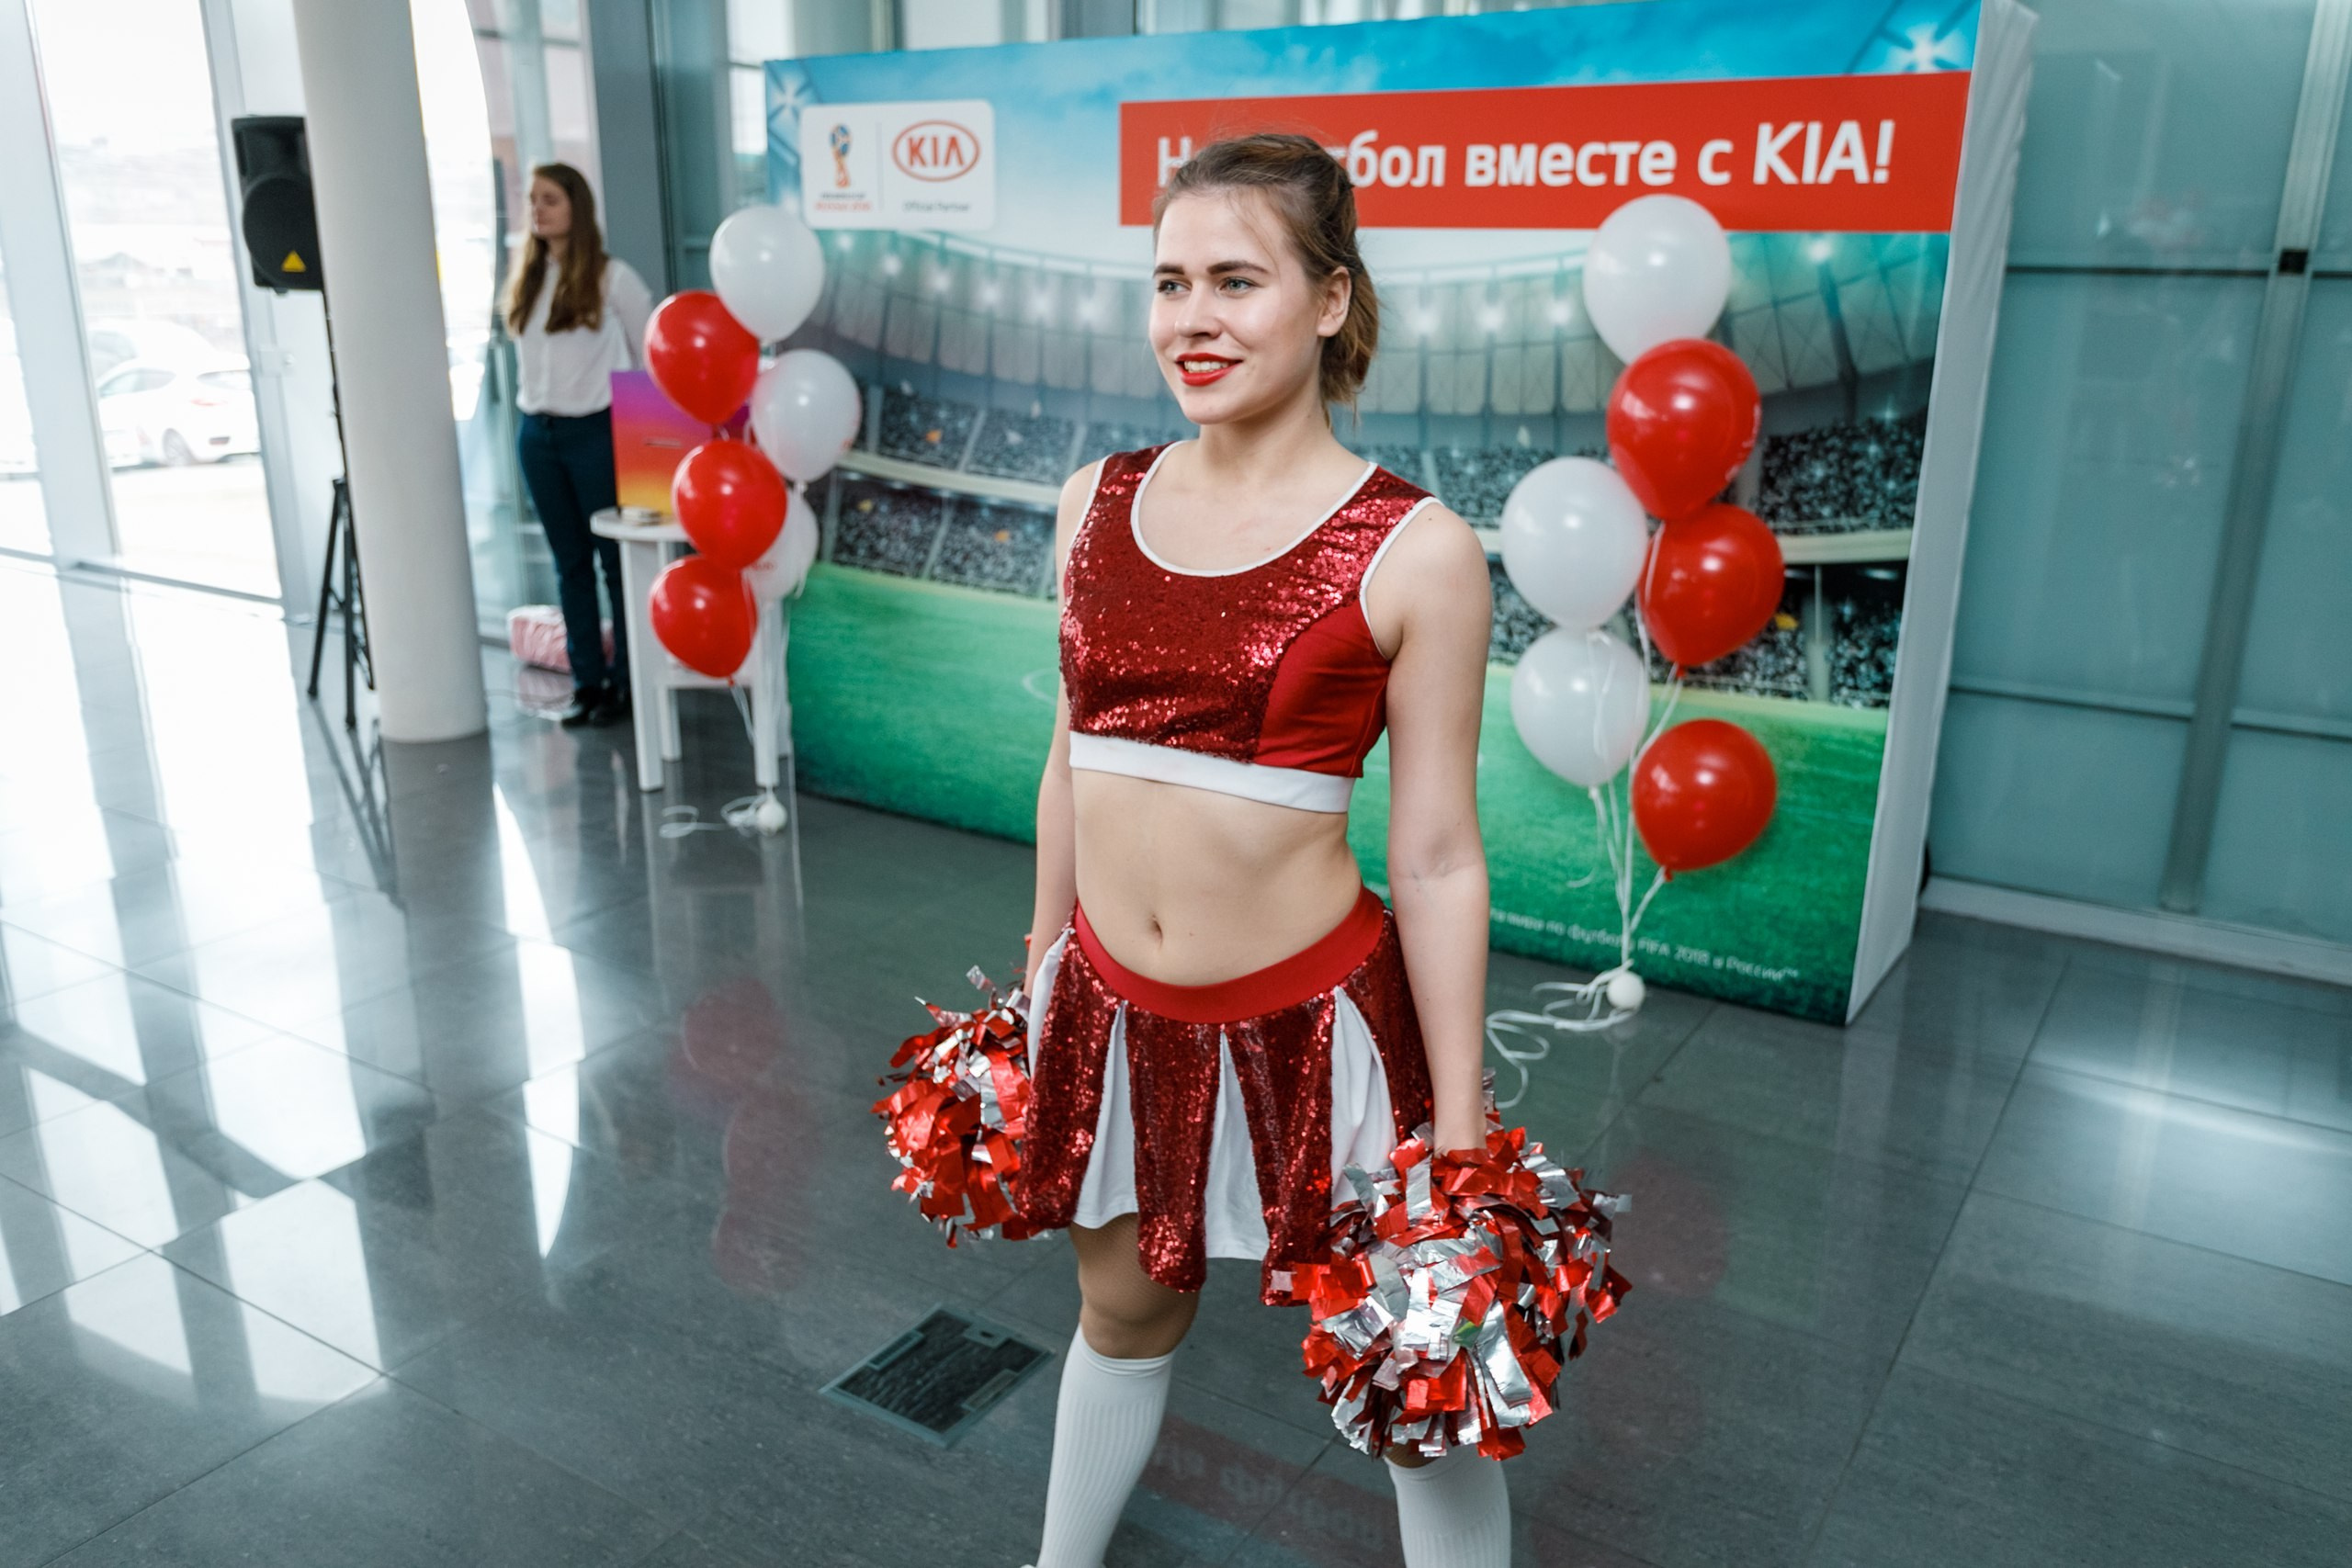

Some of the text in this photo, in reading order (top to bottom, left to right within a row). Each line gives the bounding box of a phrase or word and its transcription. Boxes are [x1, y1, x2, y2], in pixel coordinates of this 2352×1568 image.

[906, 135, 965, 168] KIA
[1321, 129, 1447, 188] бол
[1464, 139, 1678, 188] вместе
[1697, 139, 1735, 186] с
[1752, 119, 1895, 186] KIA!
[1637, 936, 1671, 957] FIFA
[1673, 943, 1711, 965] 2018
